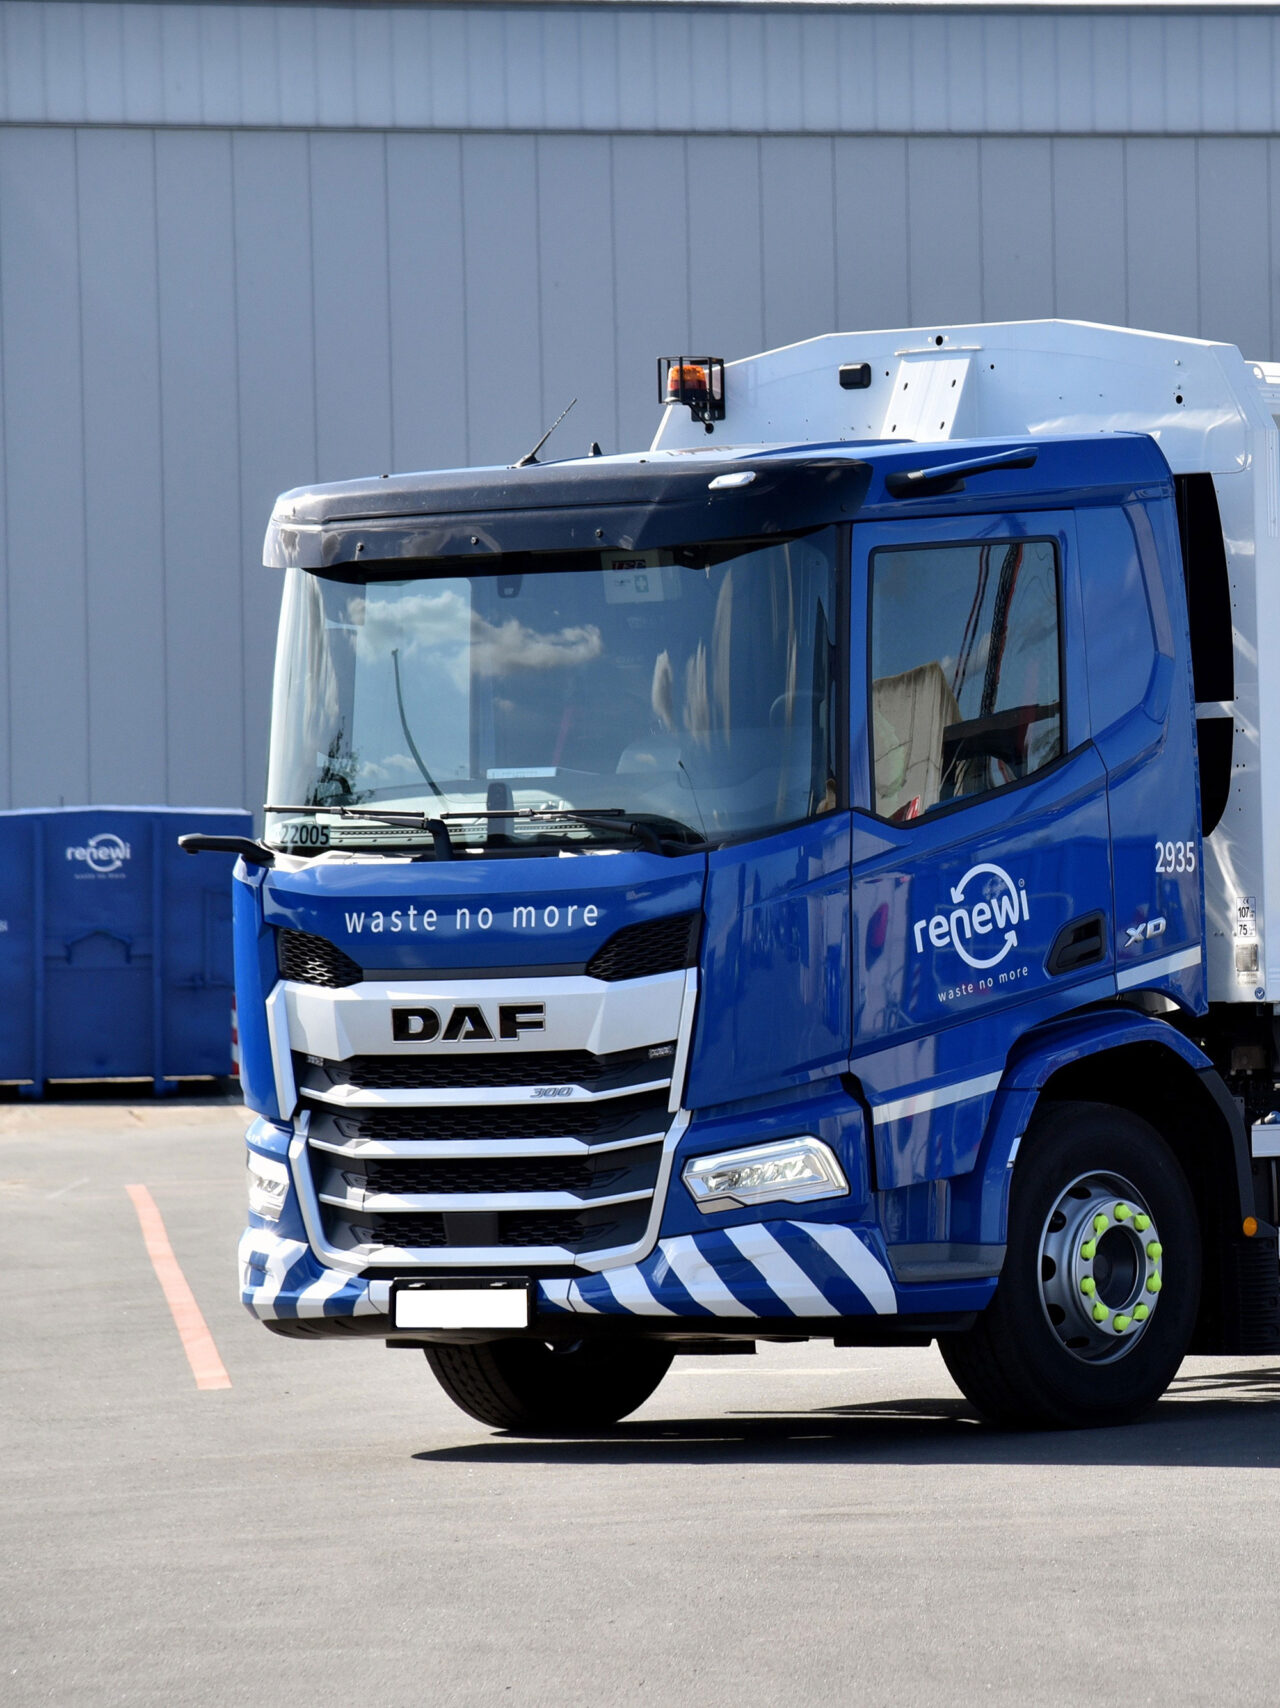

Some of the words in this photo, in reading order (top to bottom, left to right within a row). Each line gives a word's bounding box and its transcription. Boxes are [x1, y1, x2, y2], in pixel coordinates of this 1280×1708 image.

[281, 824, 329, 845] 22005
[1155, 841, 1195, 873] 2935
[345, 905, 438, 934] waste
[456, 907, 494, 930] no
[513, 904, 599, 928] more
[913, 889, 1030, 954] renewi
[1238, 906, 1250, 918] 107
[1124, 916, 1167, 948] XD
[1239, 924, 1248, 936] 75
[938, 984, 974, 1003] waste
[979, 977, 994, 991] no
[998, 966, 1028, 984] more
[391, 1002, 546, 1043] DAF
[530, 1086, 573, 1099] 300
